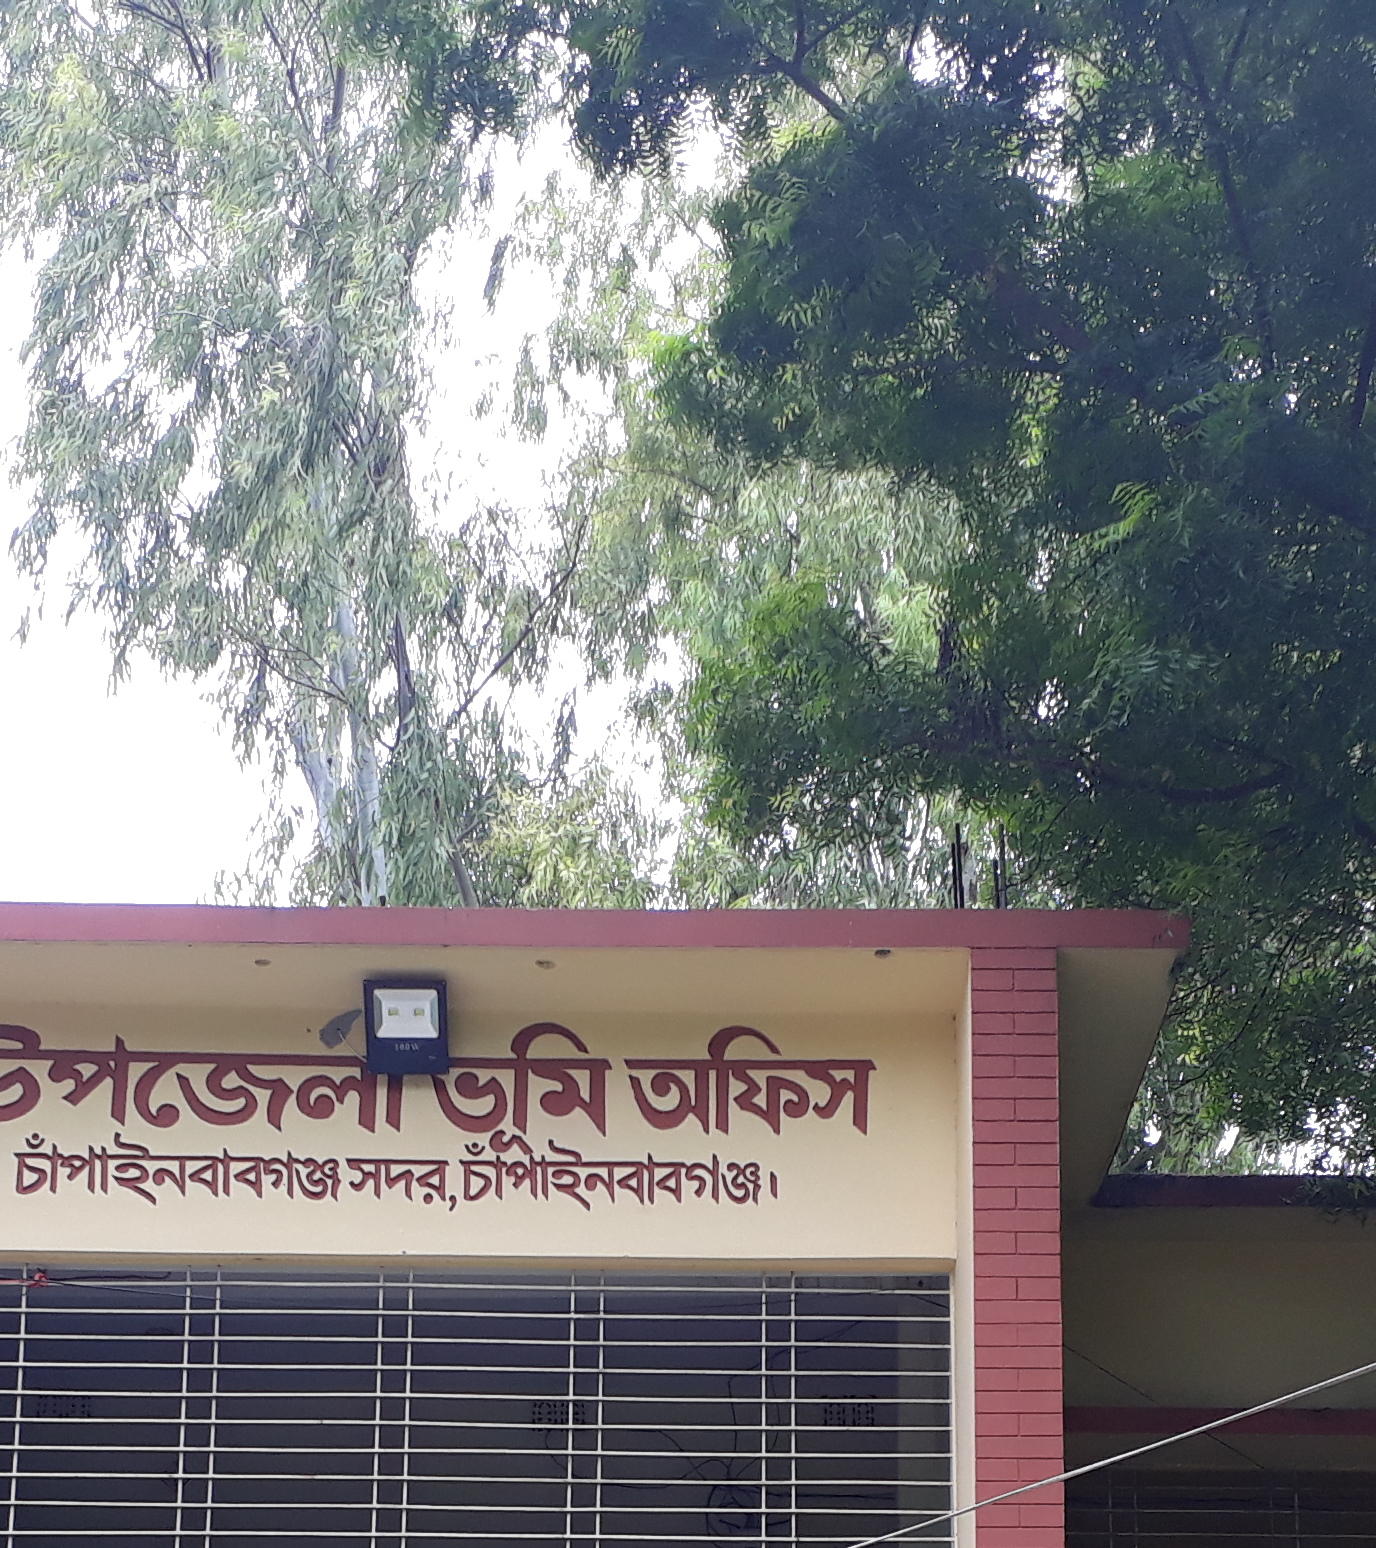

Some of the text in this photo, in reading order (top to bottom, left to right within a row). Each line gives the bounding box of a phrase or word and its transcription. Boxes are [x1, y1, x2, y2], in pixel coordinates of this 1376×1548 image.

[430, 1021, 612, 1155] ভূমি
[623, 1025, 877, 1136] অফিস
[13, 1132, 342, 1206] চাঁপাইনবাবগঞ্জ
